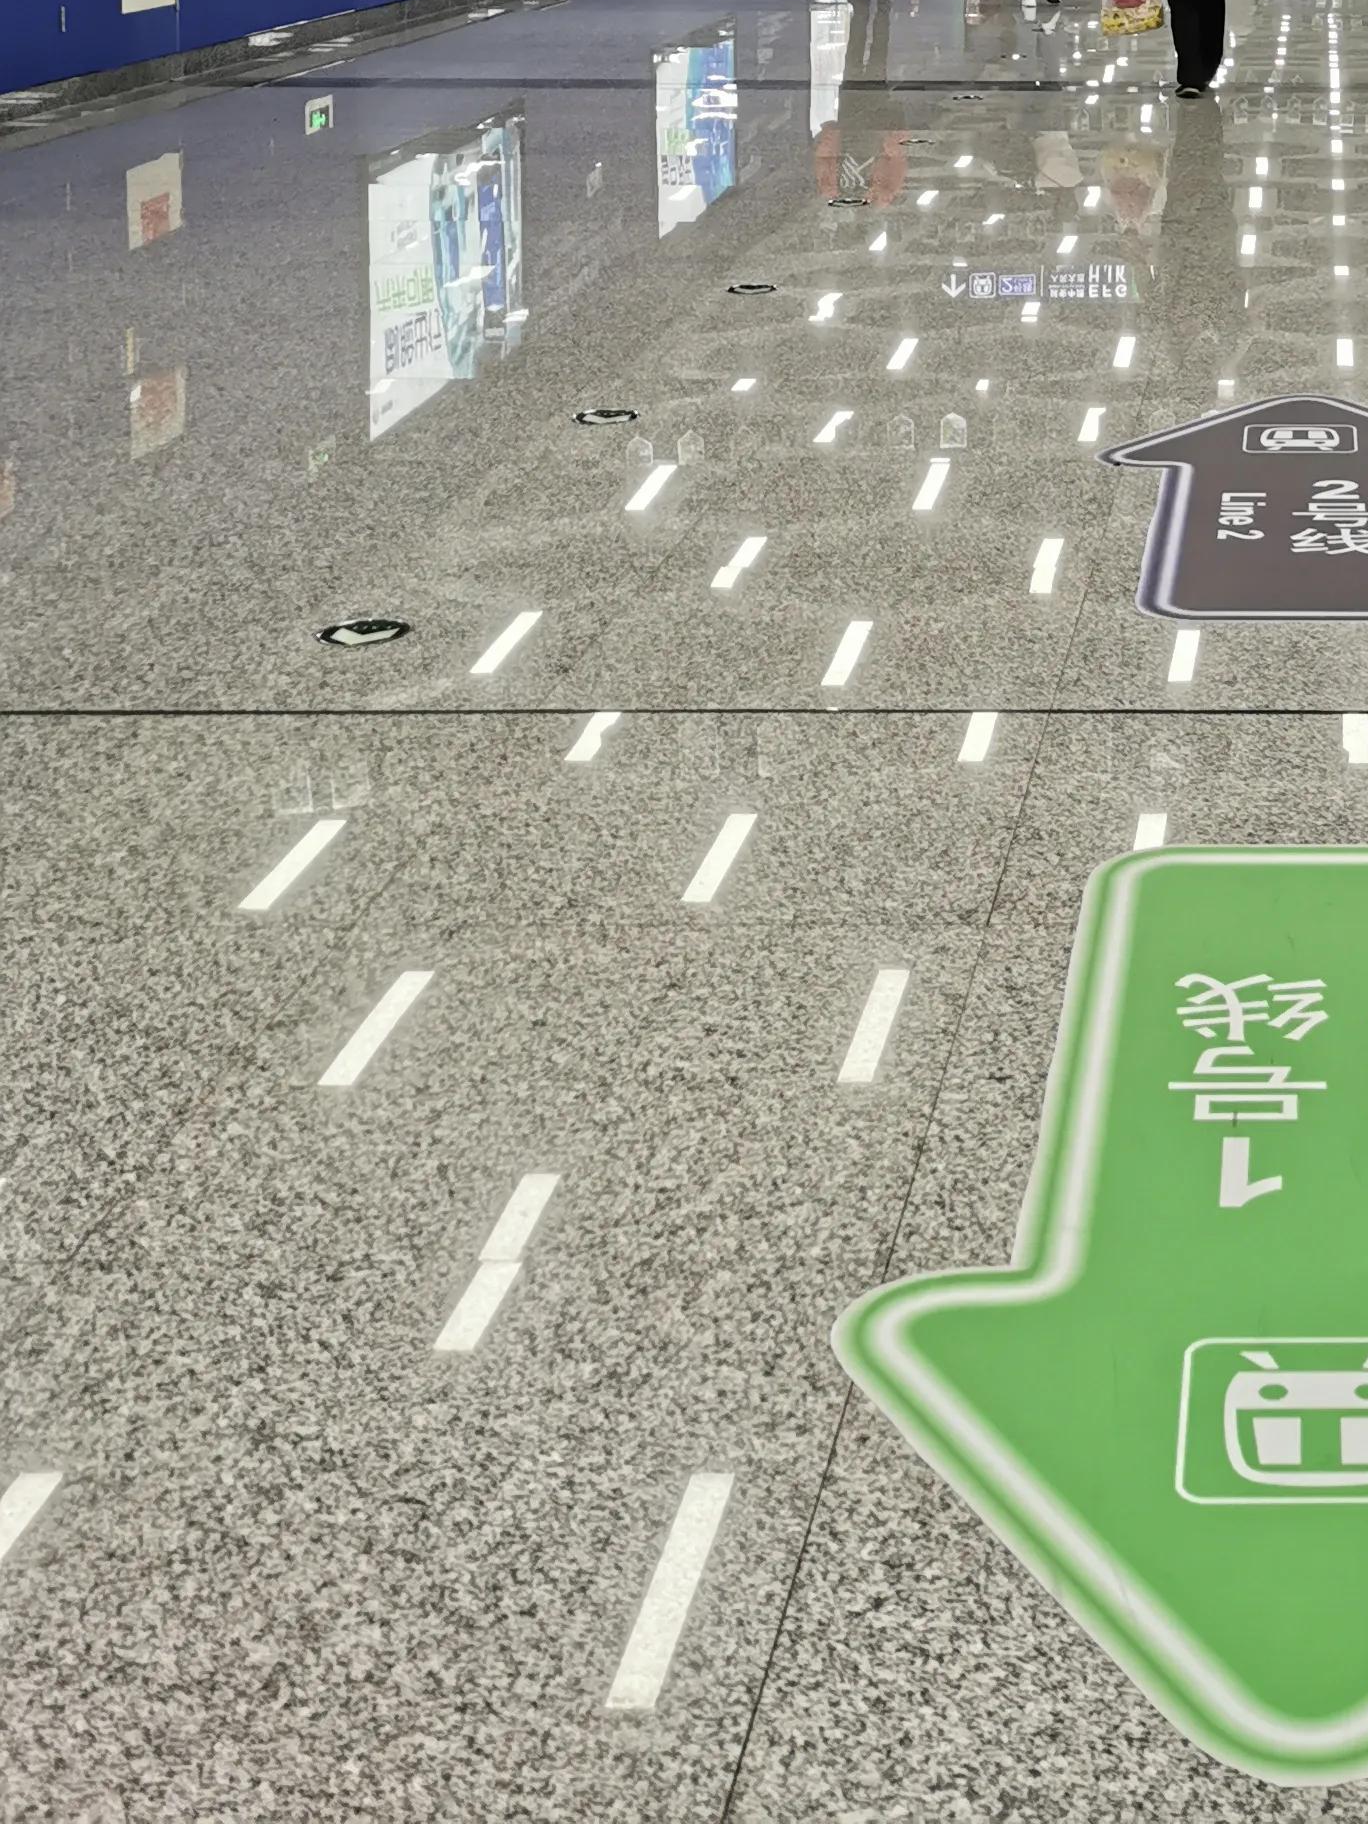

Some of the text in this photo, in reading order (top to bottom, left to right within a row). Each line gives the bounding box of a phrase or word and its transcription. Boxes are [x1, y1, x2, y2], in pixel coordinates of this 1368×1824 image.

[1217, 492, 1266, 540] Line 2
[1168, 973, 1329, 1208] 1号线
